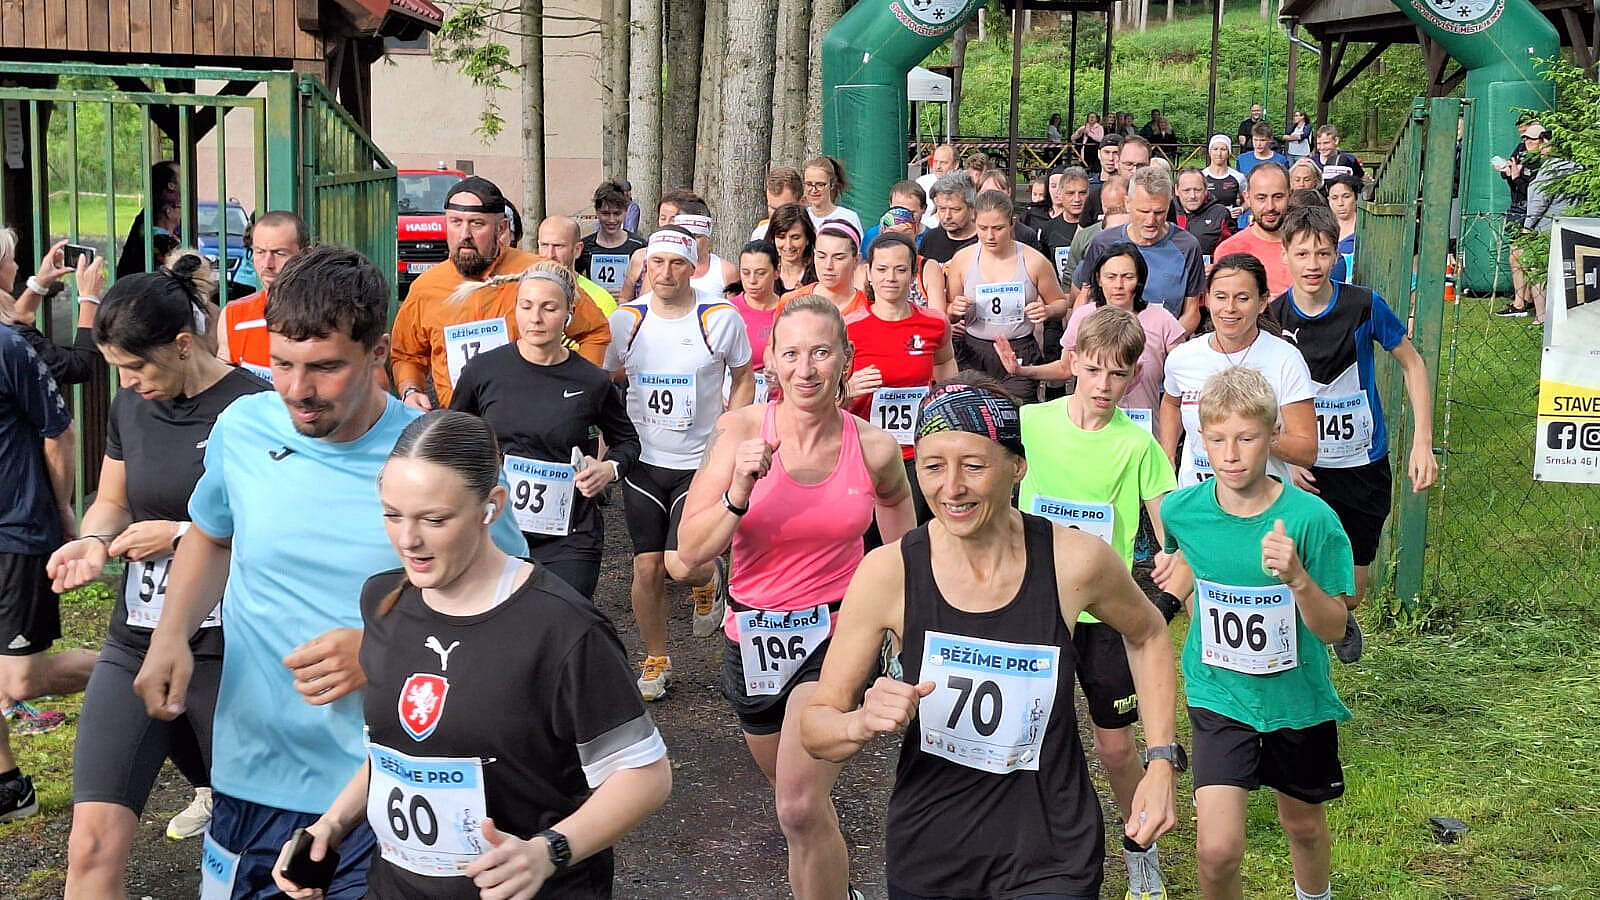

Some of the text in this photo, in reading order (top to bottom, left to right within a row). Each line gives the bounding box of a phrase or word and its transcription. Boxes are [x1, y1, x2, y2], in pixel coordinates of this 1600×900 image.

[598, 266, 616, 283] 42
[991, 296, 1001, 315] 8
[648, 389, 673, 415] 49
[1346, 398, 1361, 408] PRO
[879, 405, 912, 430] 125
[1317, 413, 1354, 440] 145
[549, 470, 569, 479] PRO
[514, 480, 547, 513] 93
[1040, 504, 1104, 520] BĚŽÍME PRO
[1208, 589, 1282, 605] BĚŽÍME PRO
[793, 616, 819, 627] PRO
[1209, 607, 1267, 652] 106
[752, 635, 807, 672] 196
[940, 646, 1002, 669] BĚŽÍME
[946, 675, 1003, 737] 70
[380, 756, 464, 783] BĚŽÍME PRO
[387, 786, 439, 846] 60
